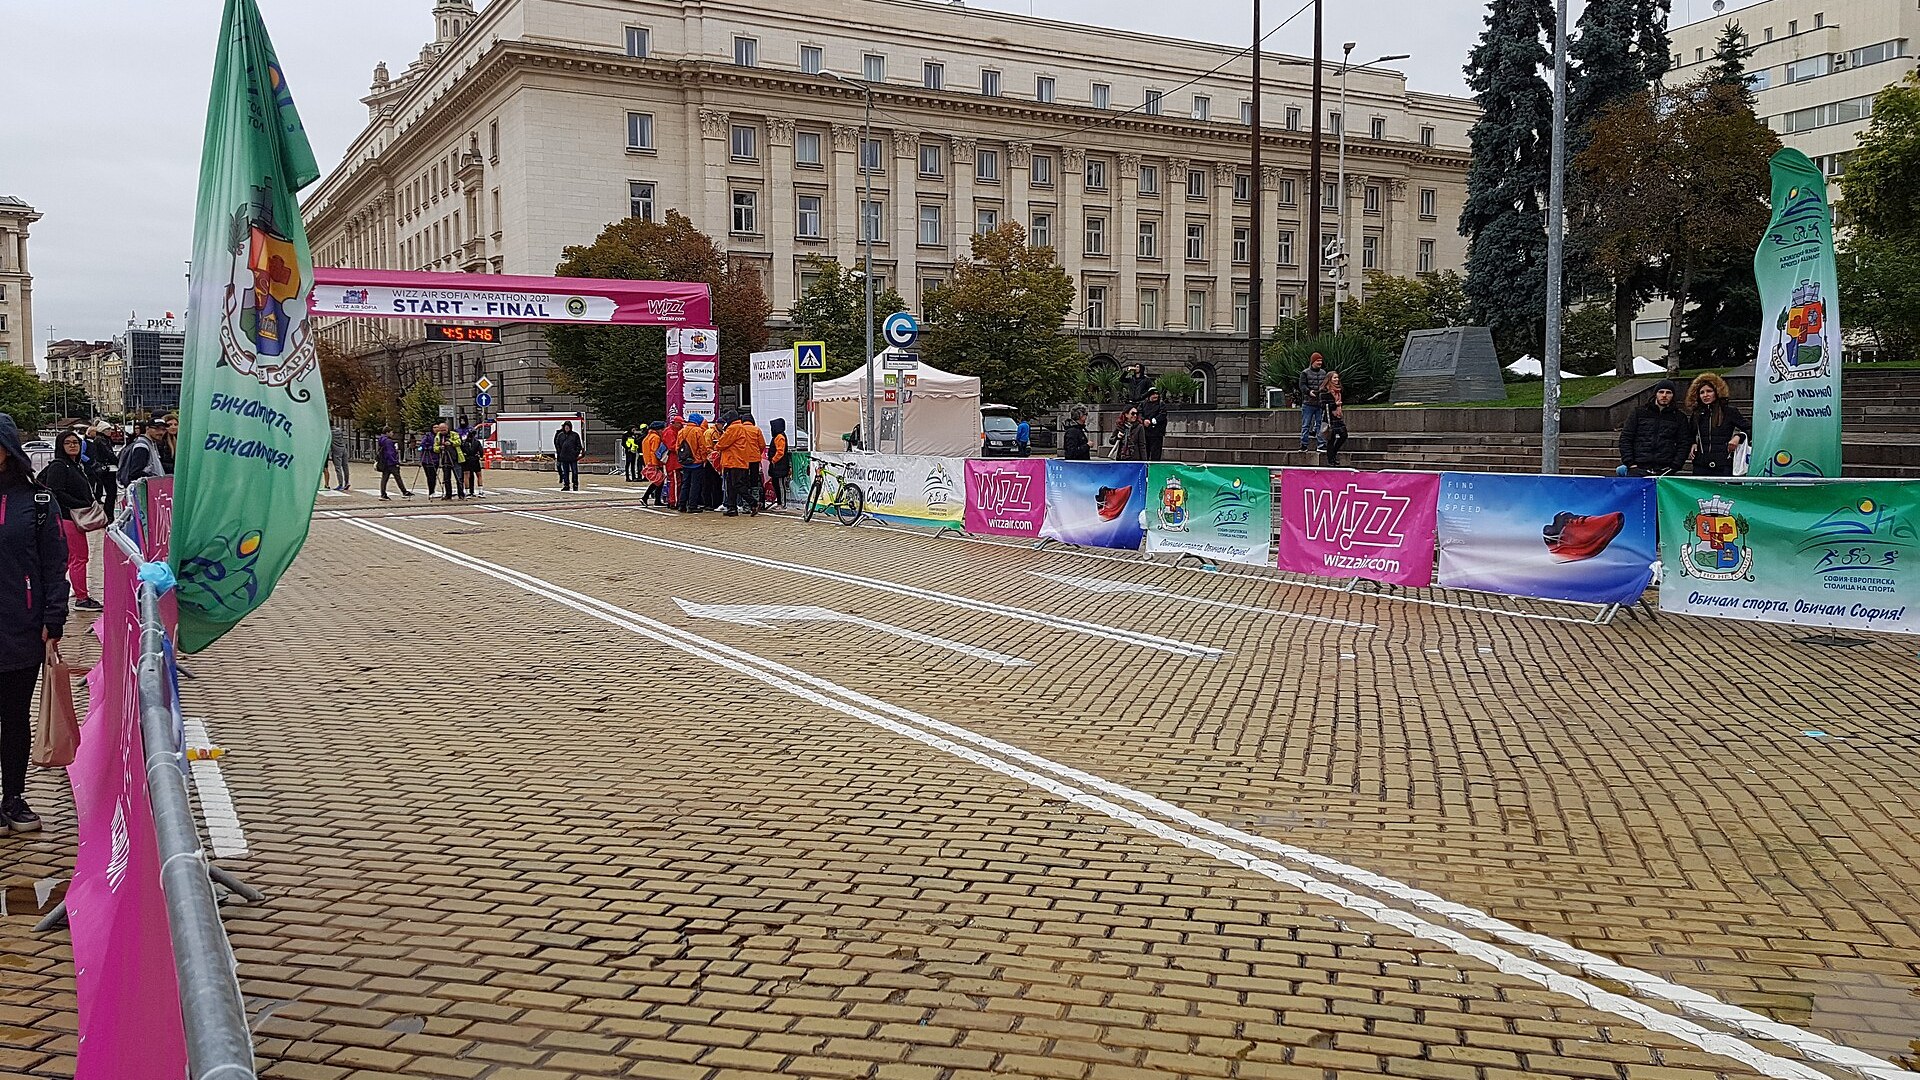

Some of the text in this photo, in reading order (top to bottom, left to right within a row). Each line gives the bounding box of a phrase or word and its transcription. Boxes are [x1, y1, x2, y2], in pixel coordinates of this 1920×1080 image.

[392, 289, 549, 303] WIZZ AIR SOFIA MARATHON 2021
[393, 299, 463, 314] START
[487, 302, 550, 317] FINAL
[147, 319, 172, 328] pwc
[442, 328, 492, 341] 4:51:46
[753, 358, 791, 370] WIZZ AIR SOFIA
[758, 371, 787, 381] MARATHON
[867, 469, 896, 486] спорта.
[1448, 481, 1473, 489] FIND
[867, 485, 897, 508] София!
[1447, 493, 1474, 501] YOUR
[1444, 504, 1481, 513] SPEED
[988, 516, 1033, 531] wizzair.com
[1324, 551, 1400, 573] wizzair.com
[1823, 582, 1855, 591] СТОЛИЦА
[1868, 585, 1896, 593] СПОРТА
[1688, 590, 1905, 623] Обичам спорта. Обичам София!
